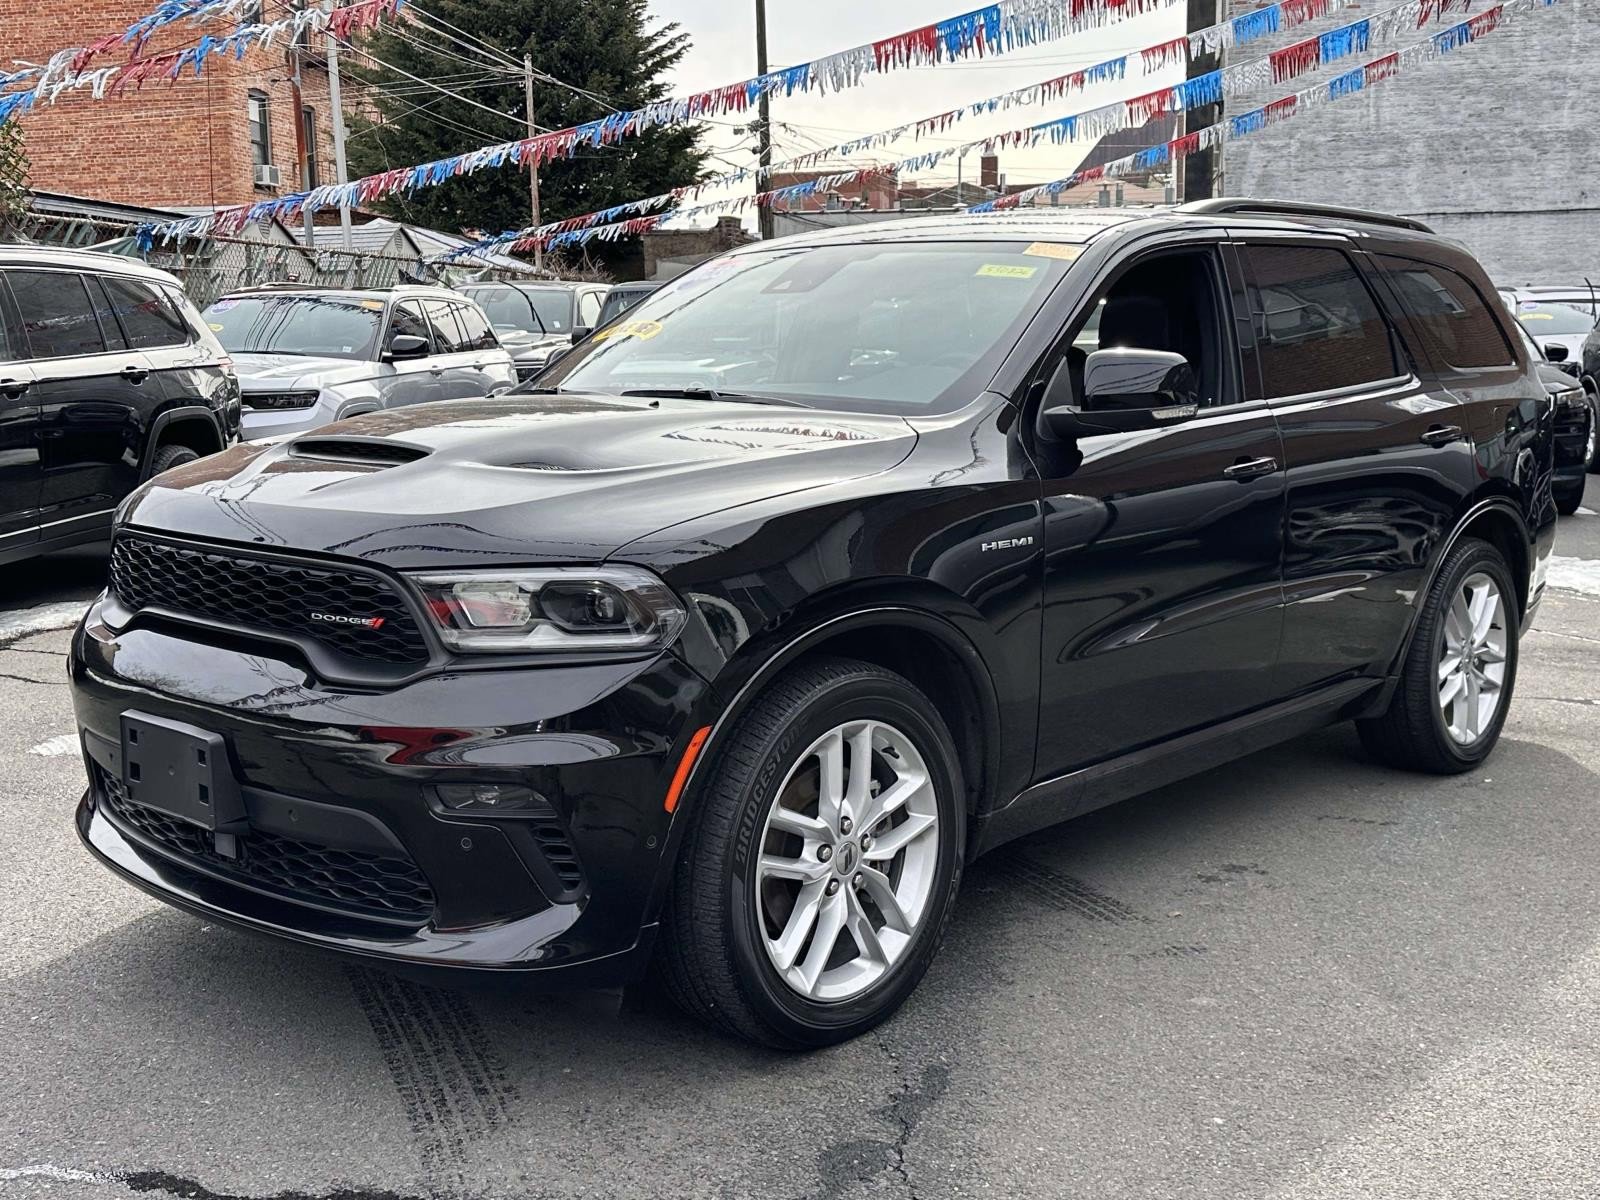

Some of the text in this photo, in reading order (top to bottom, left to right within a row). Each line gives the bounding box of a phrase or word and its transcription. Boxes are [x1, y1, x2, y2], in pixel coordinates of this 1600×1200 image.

[981, 536, 1034, 552] HEMI
[311, 612, 375, 626] DODGE
[735, 712, 809, 864] BRIDGESTONE
